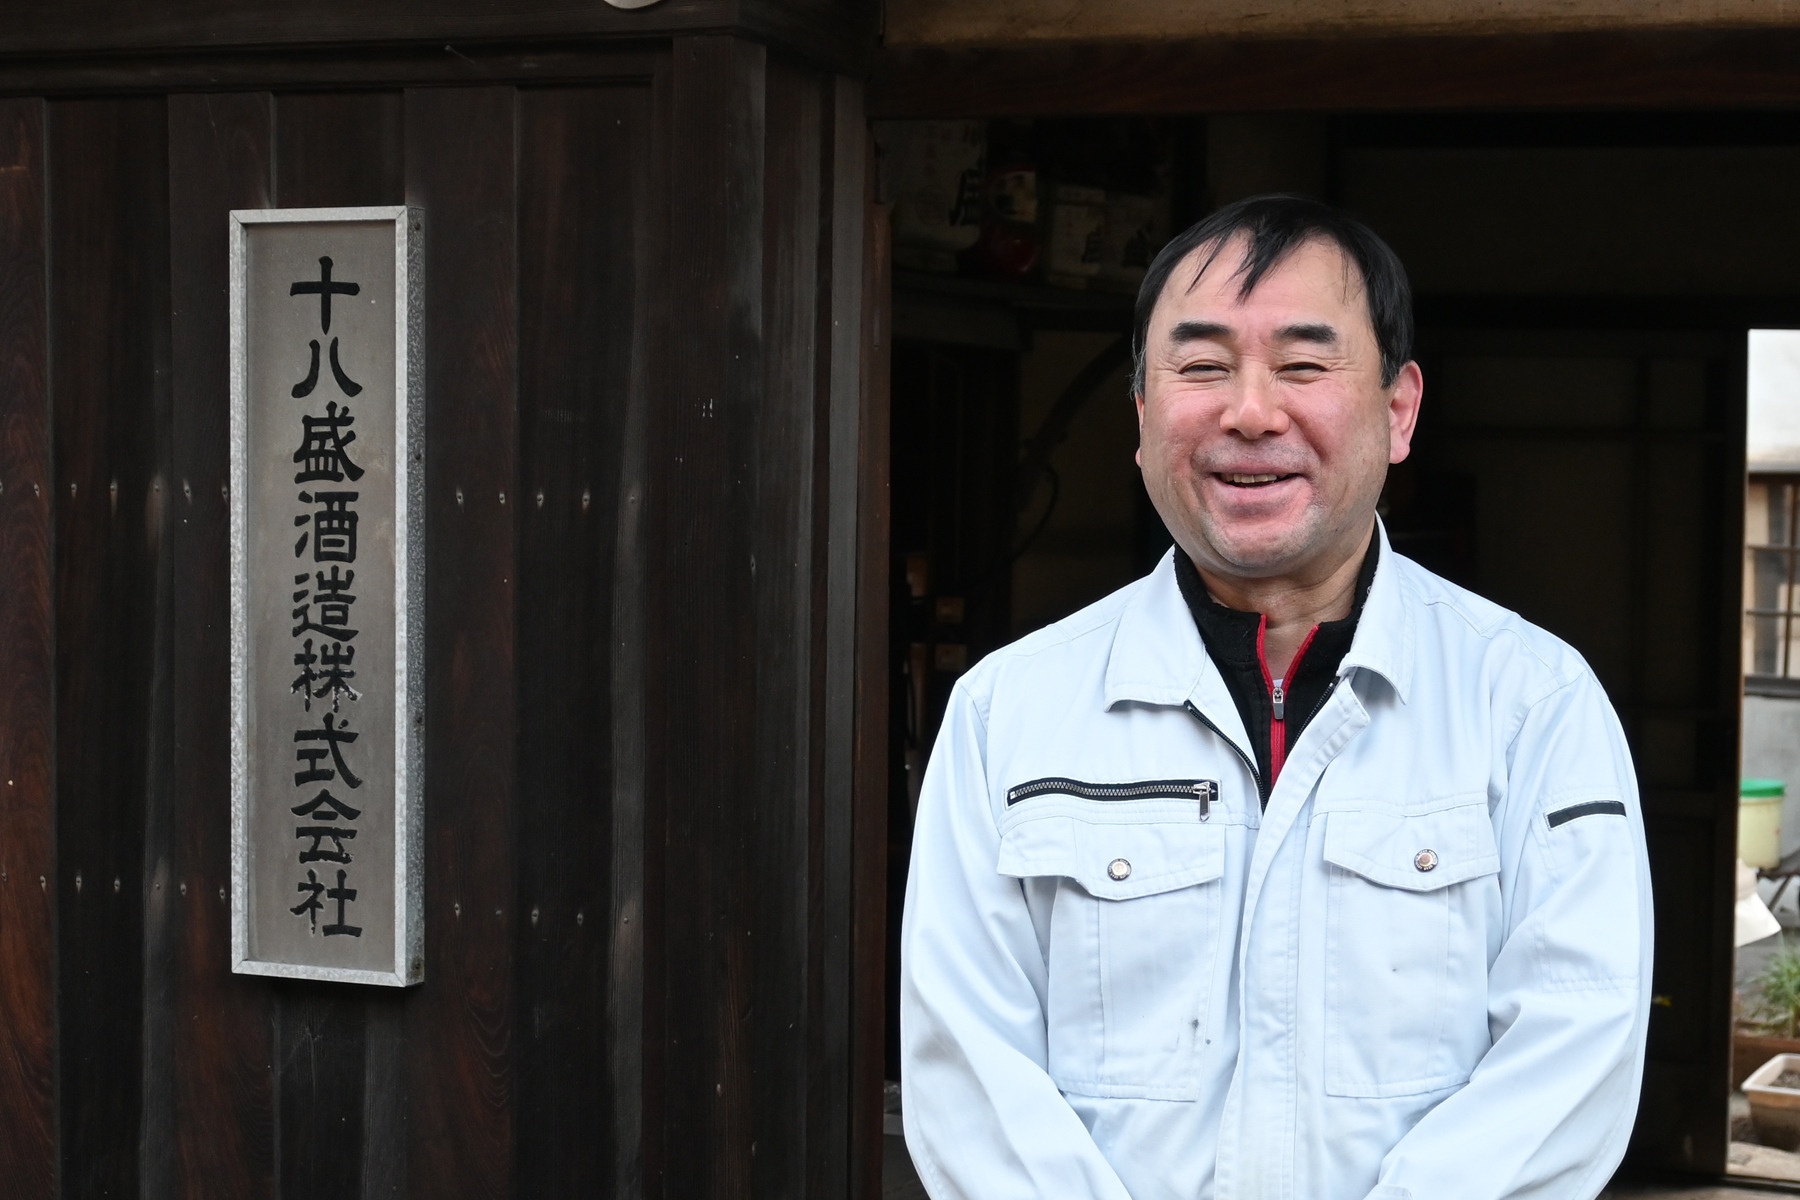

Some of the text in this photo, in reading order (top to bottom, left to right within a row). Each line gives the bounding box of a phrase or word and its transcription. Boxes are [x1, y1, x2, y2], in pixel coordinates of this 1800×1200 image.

[289, 255, 365, 938] 十八盛酒造株式会社
